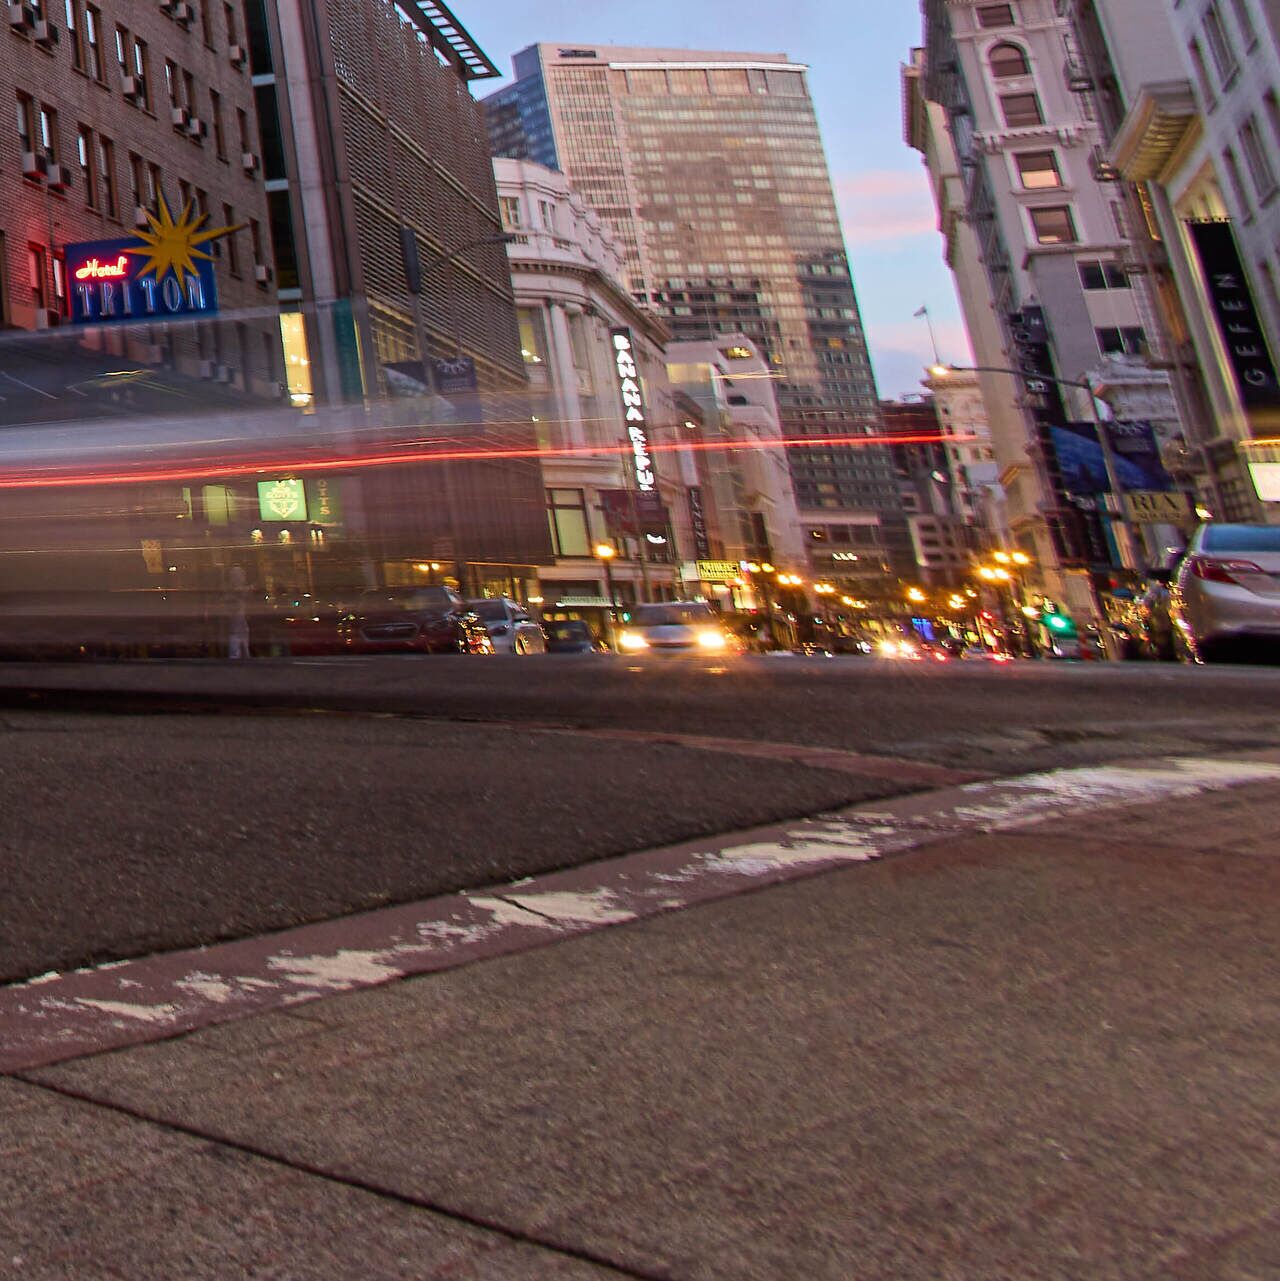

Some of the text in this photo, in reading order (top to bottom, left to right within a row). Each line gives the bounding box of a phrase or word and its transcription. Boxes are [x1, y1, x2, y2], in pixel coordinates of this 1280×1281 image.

[76, 256, 128, 279] Hotel
[77, 276, 206, 317] TRITON
[613, 334, 654, 491] BANANA REPU
